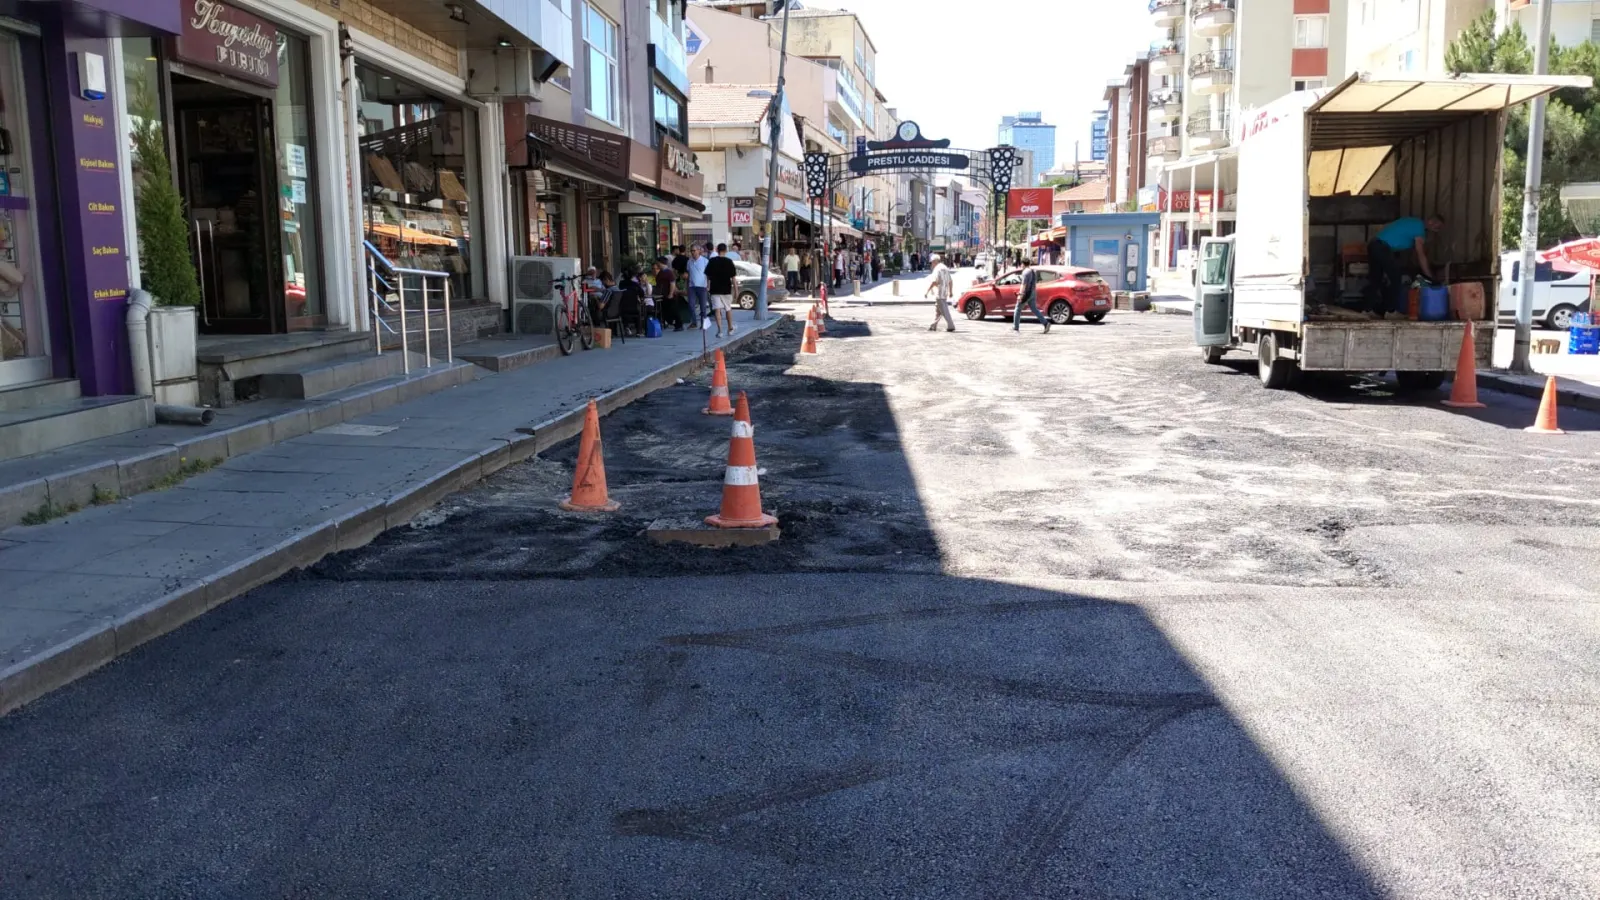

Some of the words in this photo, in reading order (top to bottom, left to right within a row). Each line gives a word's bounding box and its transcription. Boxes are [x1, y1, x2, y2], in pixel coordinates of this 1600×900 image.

[83, 114, 104, 126] Makyaj
[80, 158, 97, 168] Kişisel
[97, 160, 115, 168] Bakım
[88, 203, 98, 211] Cilt
[98, 203, 115, 211] Bakım
[733, 212, 750, 222] TAC
[92, 246, 103, 256] Saç
[102, 246, 119, 254] Bakım
[94, 290, 110, 298] Erkek
